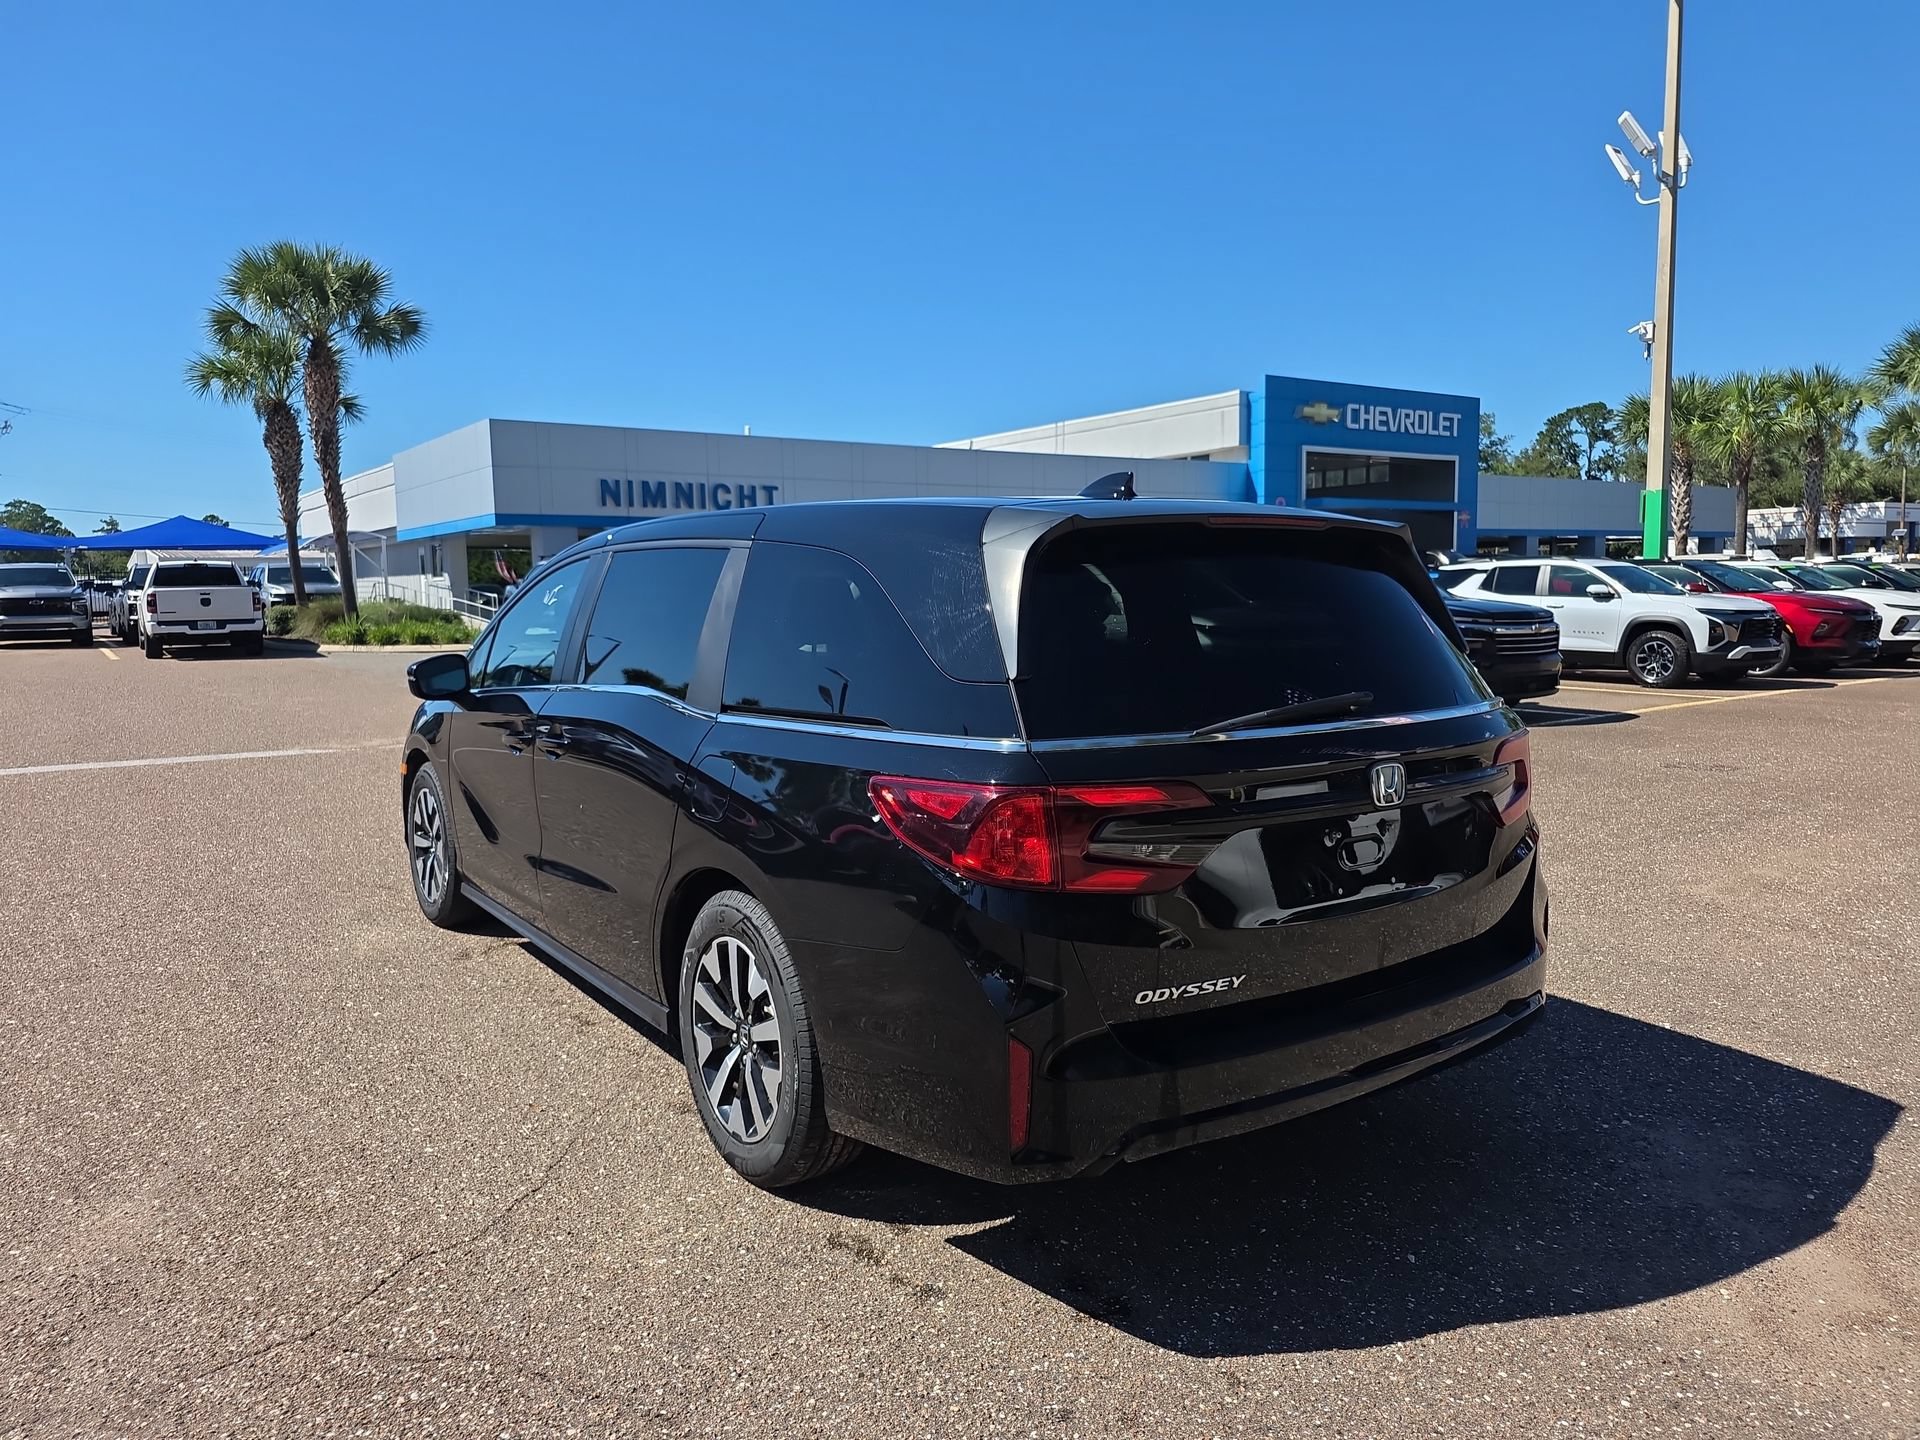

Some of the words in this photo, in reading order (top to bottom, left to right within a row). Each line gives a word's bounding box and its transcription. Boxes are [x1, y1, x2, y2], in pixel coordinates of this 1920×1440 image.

[1346, 403, 1462, 438] CHEVROLET
[600, 478, 779, 510] NIMNICHT
[1134, 974, 1247, 1005] ODYSSEY
